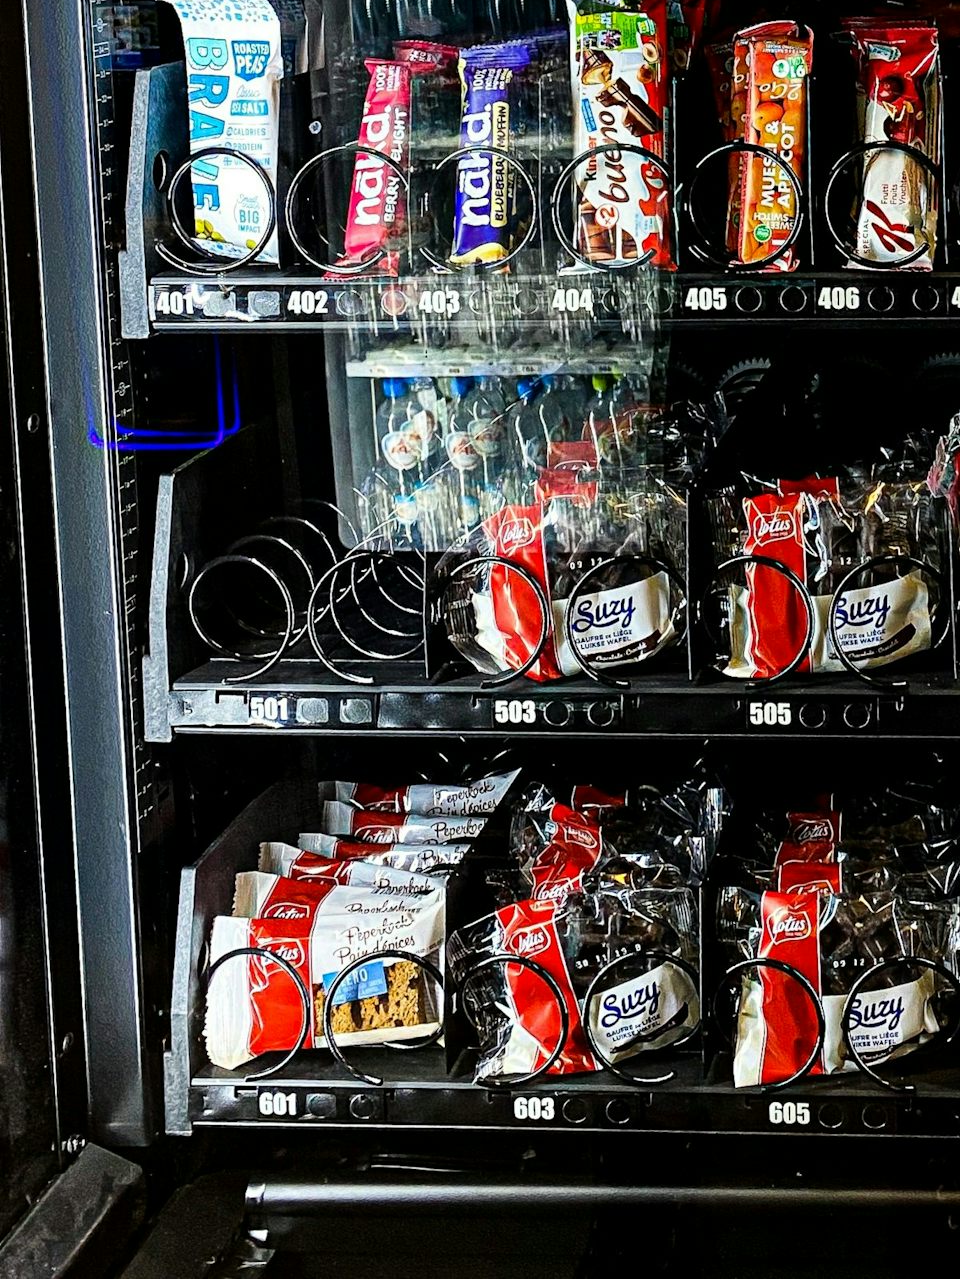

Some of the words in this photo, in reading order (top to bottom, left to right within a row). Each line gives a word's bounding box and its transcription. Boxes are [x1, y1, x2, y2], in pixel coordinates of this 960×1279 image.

[233, 42, 270, 56] ROASTED
[235, 54, 267, 76] PEAS
[241, 102, 267, 115] SALT
[186, 37, 231, 213] BRAVE
[496, 105, 508, 148] MUFFIN
[766, 120, 780, 137] &
[598, 110, 631, 204] bueno
[383, 175, 401, 223] BERRY
[494, 156, 506, 222] BLUEBERRY
[880, 182, 890, 206] Frutti
[889, 182, 899, 206] Fruits
[237, 224, 261, 234] IMPACT
[238, 209, 260, 225] BIG
[157, 291, 194, 315] 401
[287, 290, 329, 314] 402
[419, 290, 460, 313] 403
[552, 288, 594, 312] 404
[685, 287, 727, 311] 405
[818, 286, 861, 310] 406
[572, 595, 637, 633] Suzy
[834, 593, 891, 631] Suzy
[606, 636, 632, 647] WAFEL
[250, 697, 288, 721] 501
[494, 700, 537, 723] 503
[749, 702, 792, 726] 505
[601, 979, 660, 1028] Suzy
[848, 995, 904, 1031] Suzy
[258, 1092, 297, 1116] 601
[513, 1096, 555, 1120] 603
[768, 1101, 811, 1125] 605
